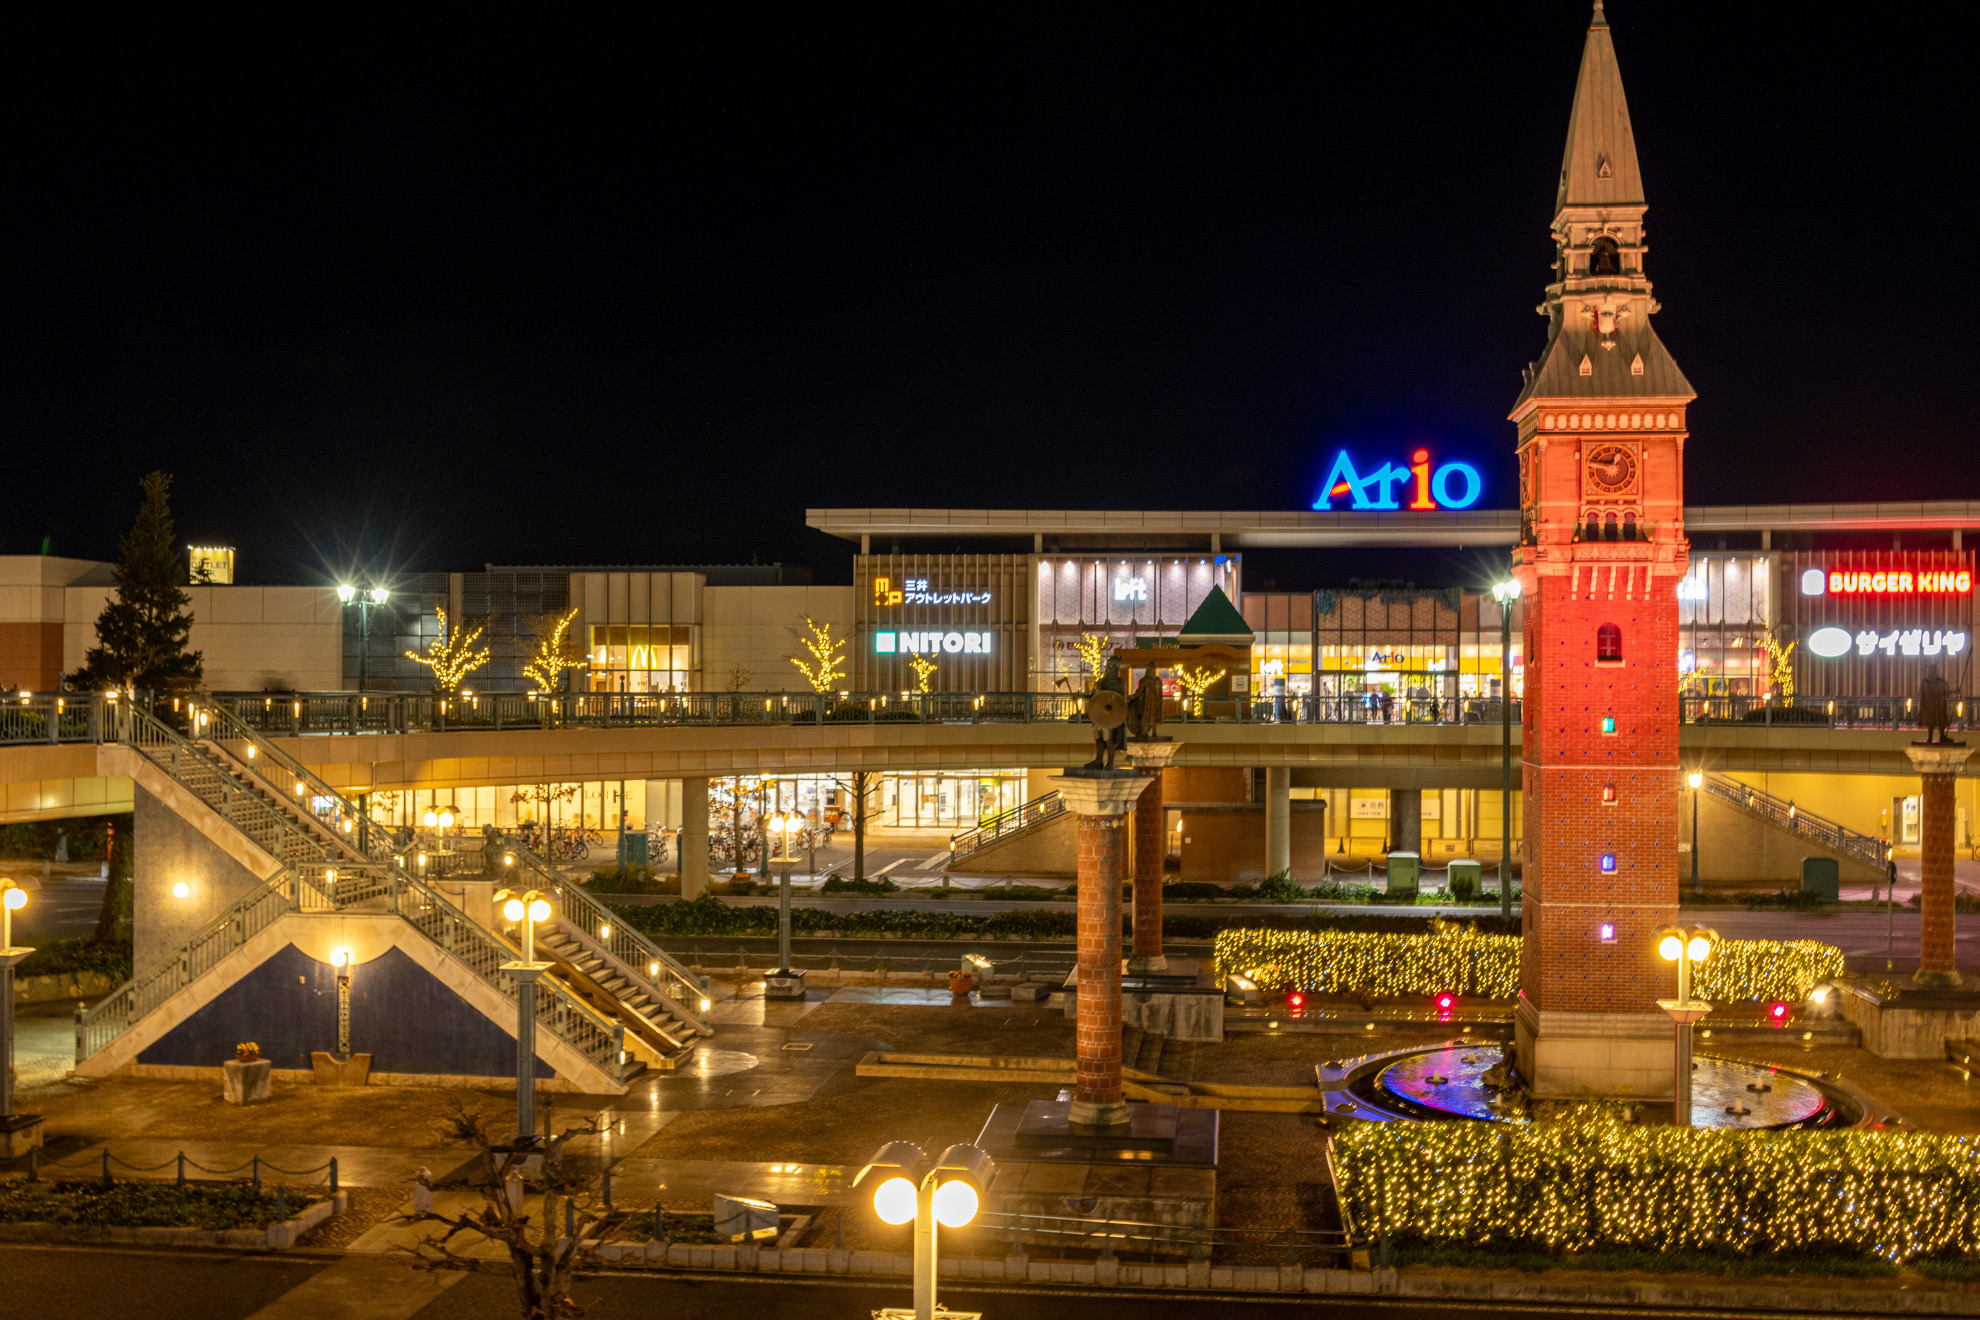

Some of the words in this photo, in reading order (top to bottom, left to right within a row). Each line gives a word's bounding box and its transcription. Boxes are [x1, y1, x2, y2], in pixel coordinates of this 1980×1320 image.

[1312, 448, 1481, 510] Ario
[905, 579, 928, 591] 三井
[1830, 572, 1913, 592] BURGER
[1918, 571, 1971, 592] KING
[905, 592, 991, 605] アウトレットパーク
[899, 632, 991, 653] NITORI
[1856, 629, 1965, 655] サイゼリヤ
[1372, 652, 1405, 664] Ario
